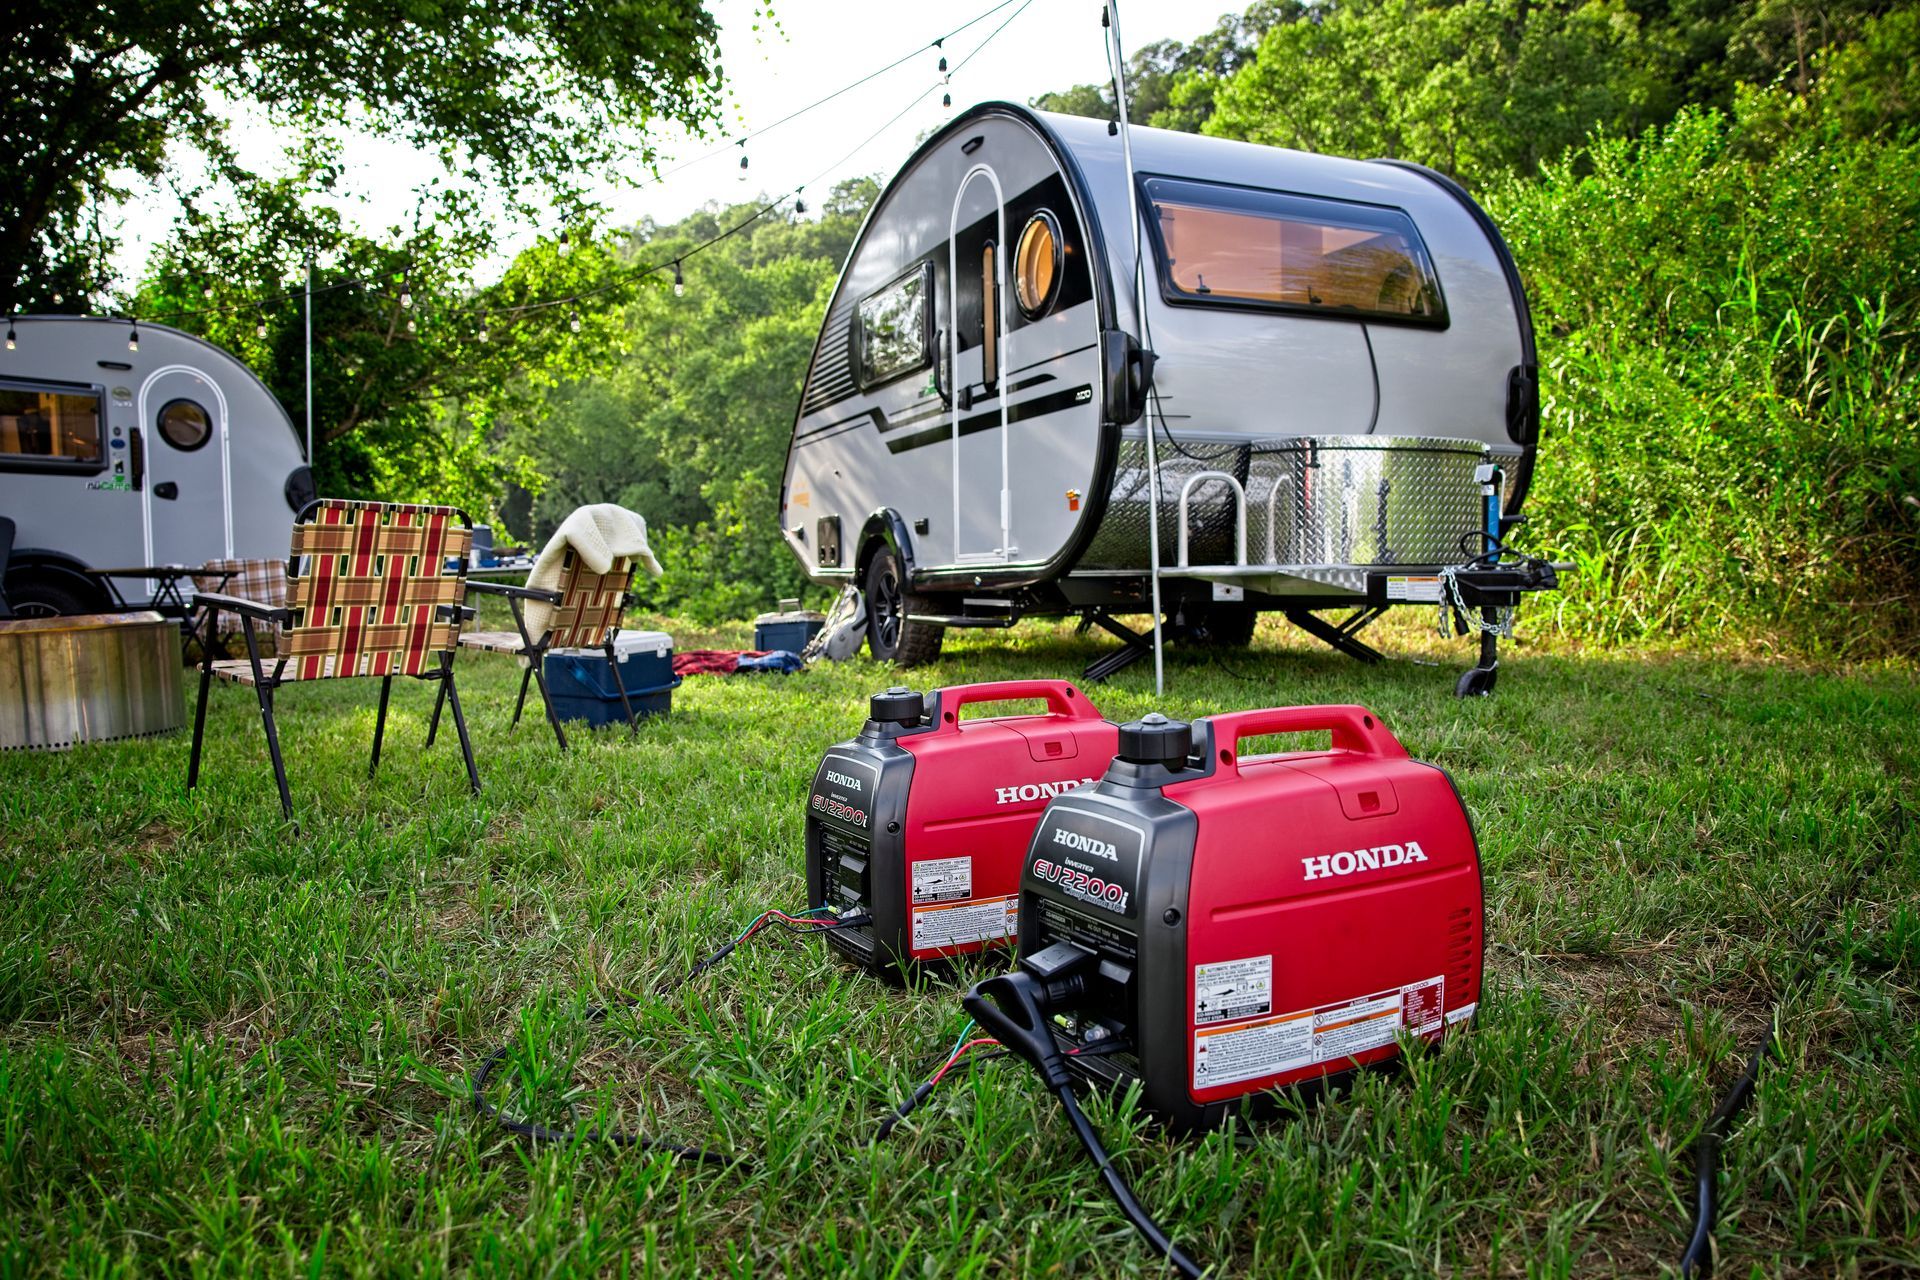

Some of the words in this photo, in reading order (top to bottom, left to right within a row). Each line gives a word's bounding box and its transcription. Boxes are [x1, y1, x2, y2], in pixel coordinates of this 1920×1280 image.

[826, 770, 862, 792] HONDA
[995, 777, 1100, 805] HOND
[812, 794, 868, 828] EU2200i
[1053, 828, 1119, 862] HONDA
[1301, 841, 1428, 881] HONDA
[1033, 858, 1130, 909] EU2200i
